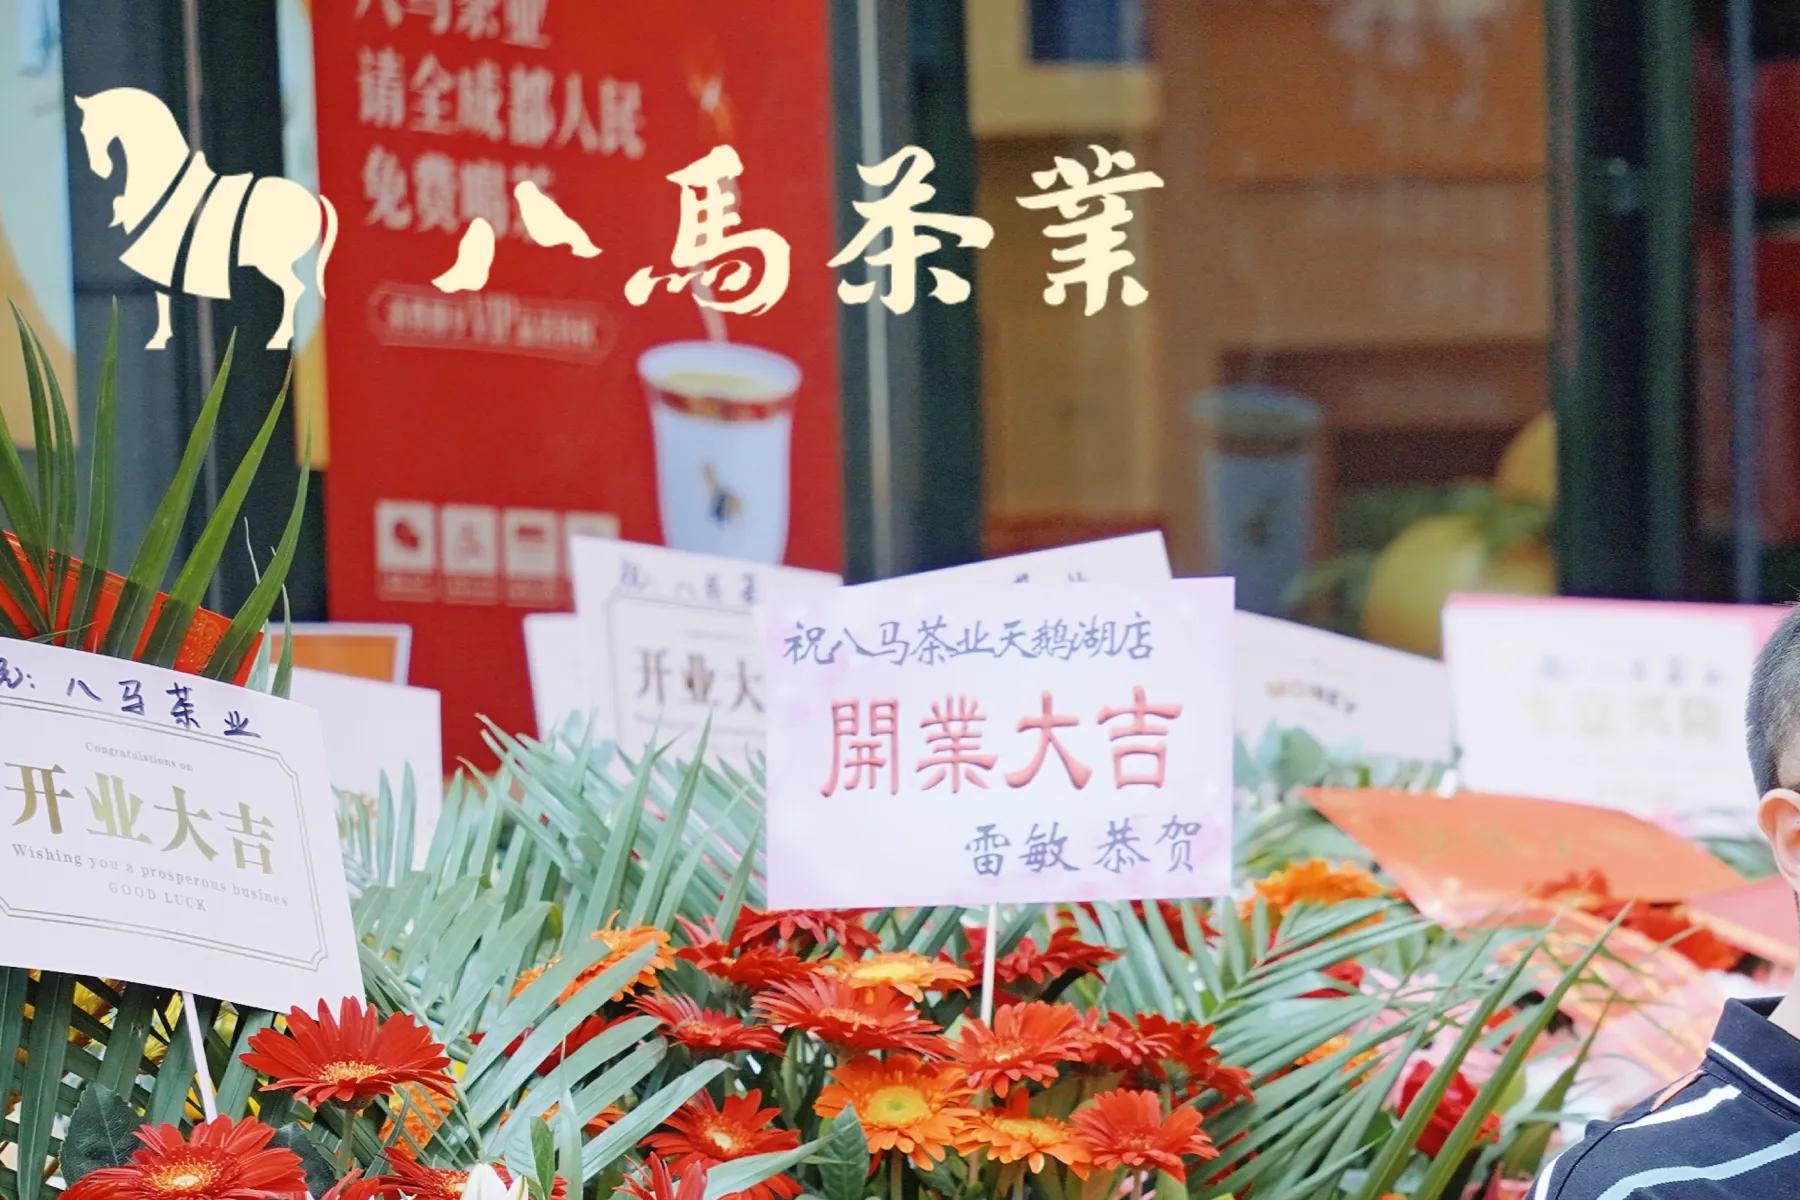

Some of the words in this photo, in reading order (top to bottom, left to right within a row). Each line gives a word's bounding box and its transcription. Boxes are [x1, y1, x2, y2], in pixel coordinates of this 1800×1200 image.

[357, 46, 647, 160] 请全成都人民
[782, 611, 1155, 665] 祝八马茶业天鹅湖店
[84, 741, 176, 770] Congratulations
[179, 762, 194, 772] on
[820, 685, 1183, 797] 開業大吉
[4, 762, 275, 875] 开业大吉
[11, 843, 83, 868] Wishing
[89, 856, 119, 873] you
[126, 864, 134, 874] a
[140, 864, 227, 894] prosperous
[109, 882, 157, 901] GOOD
[164, 892, 208, 912] LUCK
